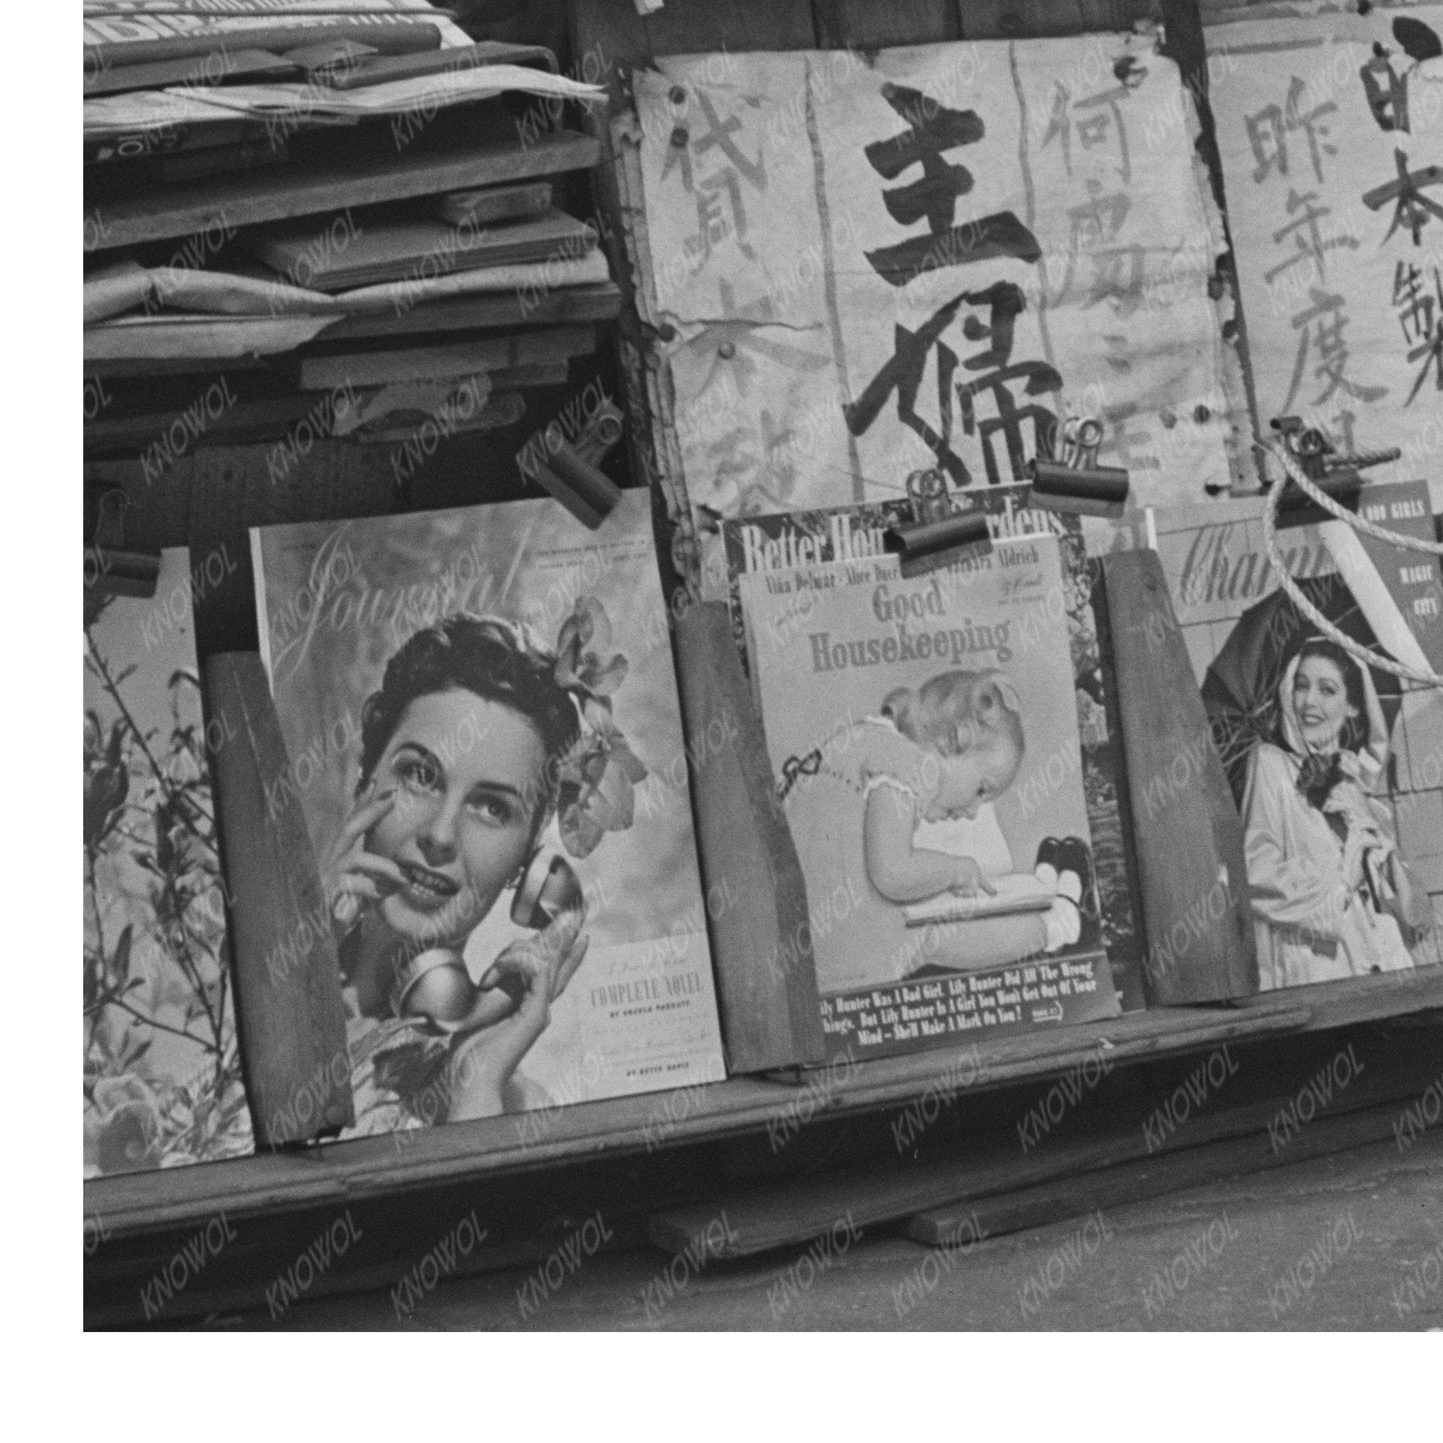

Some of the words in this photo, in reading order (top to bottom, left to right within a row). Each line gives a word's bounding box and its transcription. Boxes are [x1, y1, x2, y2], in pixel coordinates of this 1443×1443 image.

[842, 80, 1065, 488] 主婦
[1390, 499, 1425, 519] GIRLS
[740, 524, 827, 572] Better
[1000, 545, 1040, 569] Aldrich
[871, 579, 948, 624] Good
[807, 617, 1015, 673] Housekeeping
[591, 979, 662, 1008] COMPLETE
[665, 971, 706, 998] NOVEL
[836, 996, 872, 1015] Hunter
[872, 991, 894, 1008] Was
[902, 985, 922, 1004] Bad
[949, 979, 967, 999] Lily
[969, 975, 1002, 992] Hunter
[1004, 970, 1022, 987] Did
[1040, 965, 1060, 981] The
[1061, 961, 1094, 980] Wrong
[860, 1011, 878, 1028] But
[881, 1007, 899, 1026] Lily
[901, 1003, 935, 1021] Hunter
[936, 1000, 947, 1016] Is
[957, 995, 976, 1012] Girl
[978, 992, 996, 1009] You
[1022, 985, 1039, 1001] Get
[1040, 982, 1059, 998] Out
[1059, 980, 1071, 995] Of
[1073, 978, 1098, 994] Your
[857, 1029, 884, 1046] Mind
[920, 1019, 946, 1036] Make
[956, 1013, 983, 1031] Mark
[983, 1011, 997, 1026] On
